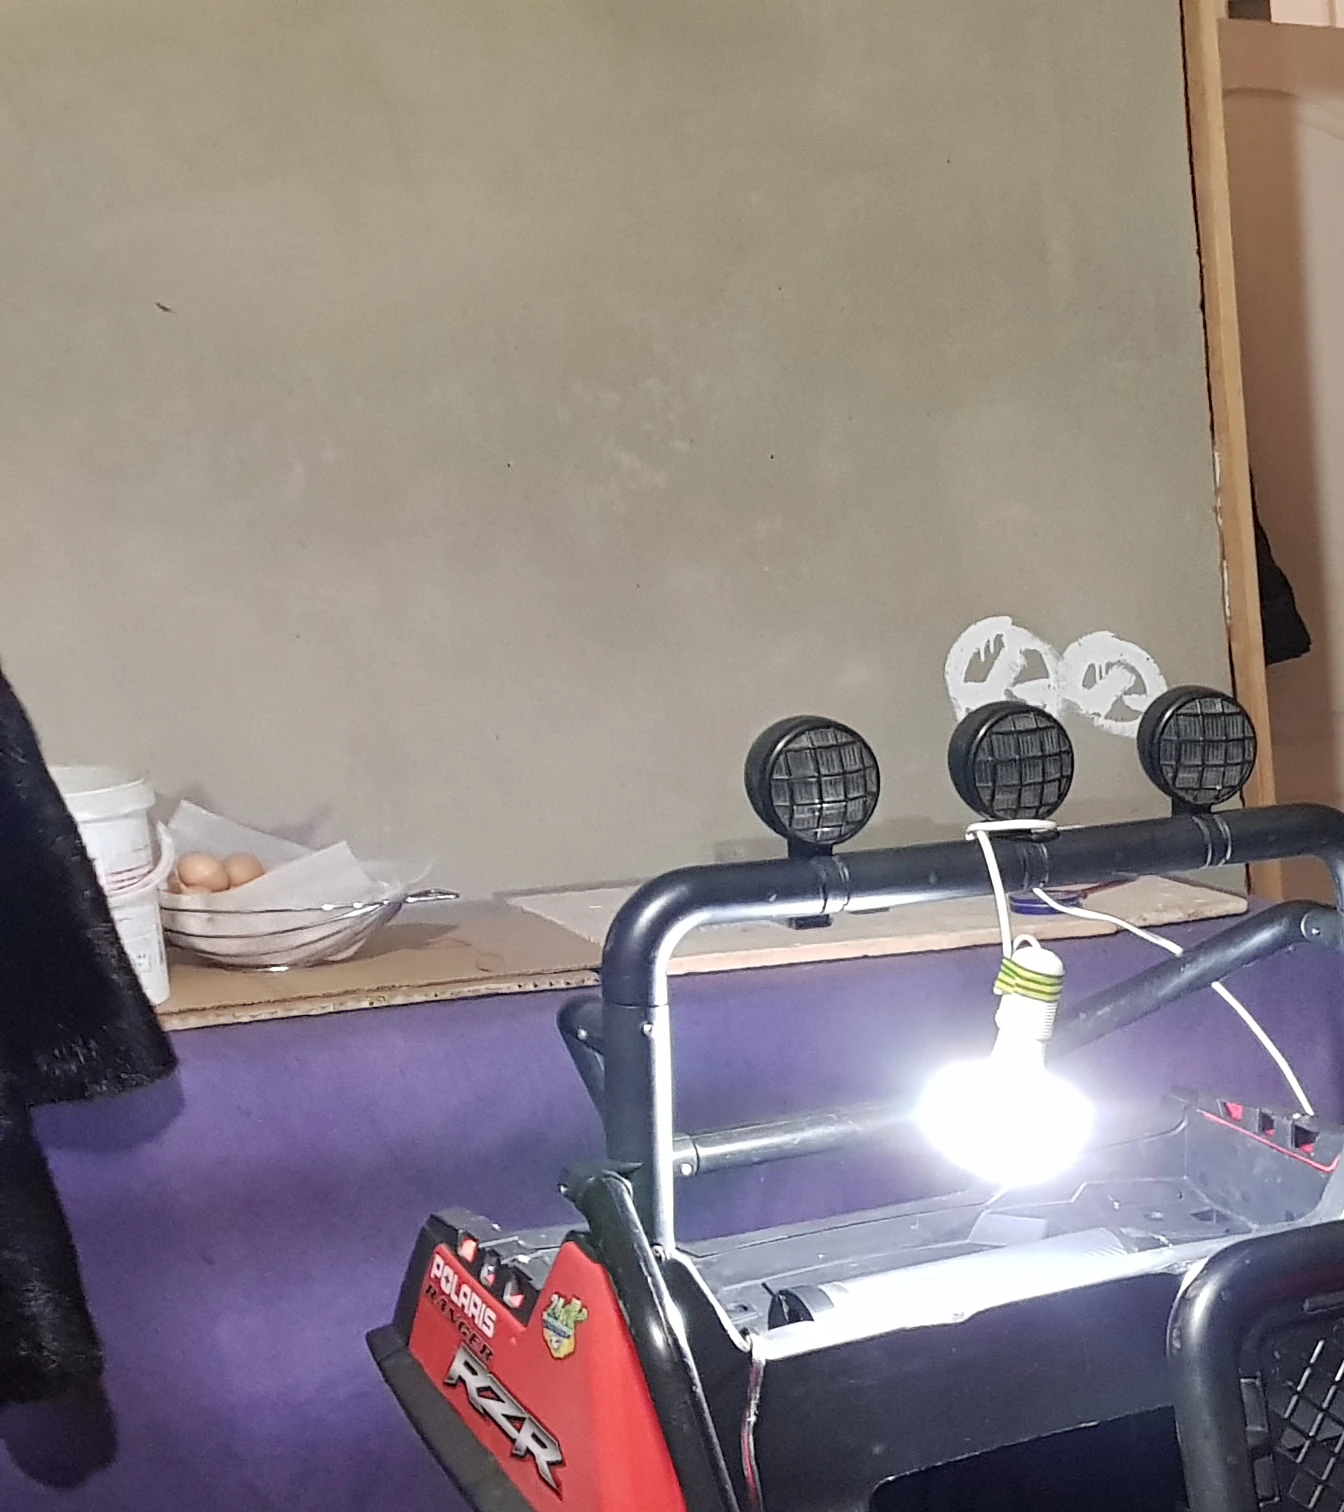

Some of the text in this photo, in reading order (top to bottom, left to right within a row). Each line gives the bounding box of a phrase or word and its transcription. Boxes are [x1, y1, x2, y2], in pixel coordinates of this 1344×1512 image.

[425, 1285, 494, 1362] RANGER
[430, 1254, 497, 1338] POLARIS
[444, 1342, 564, 1499] RZR
